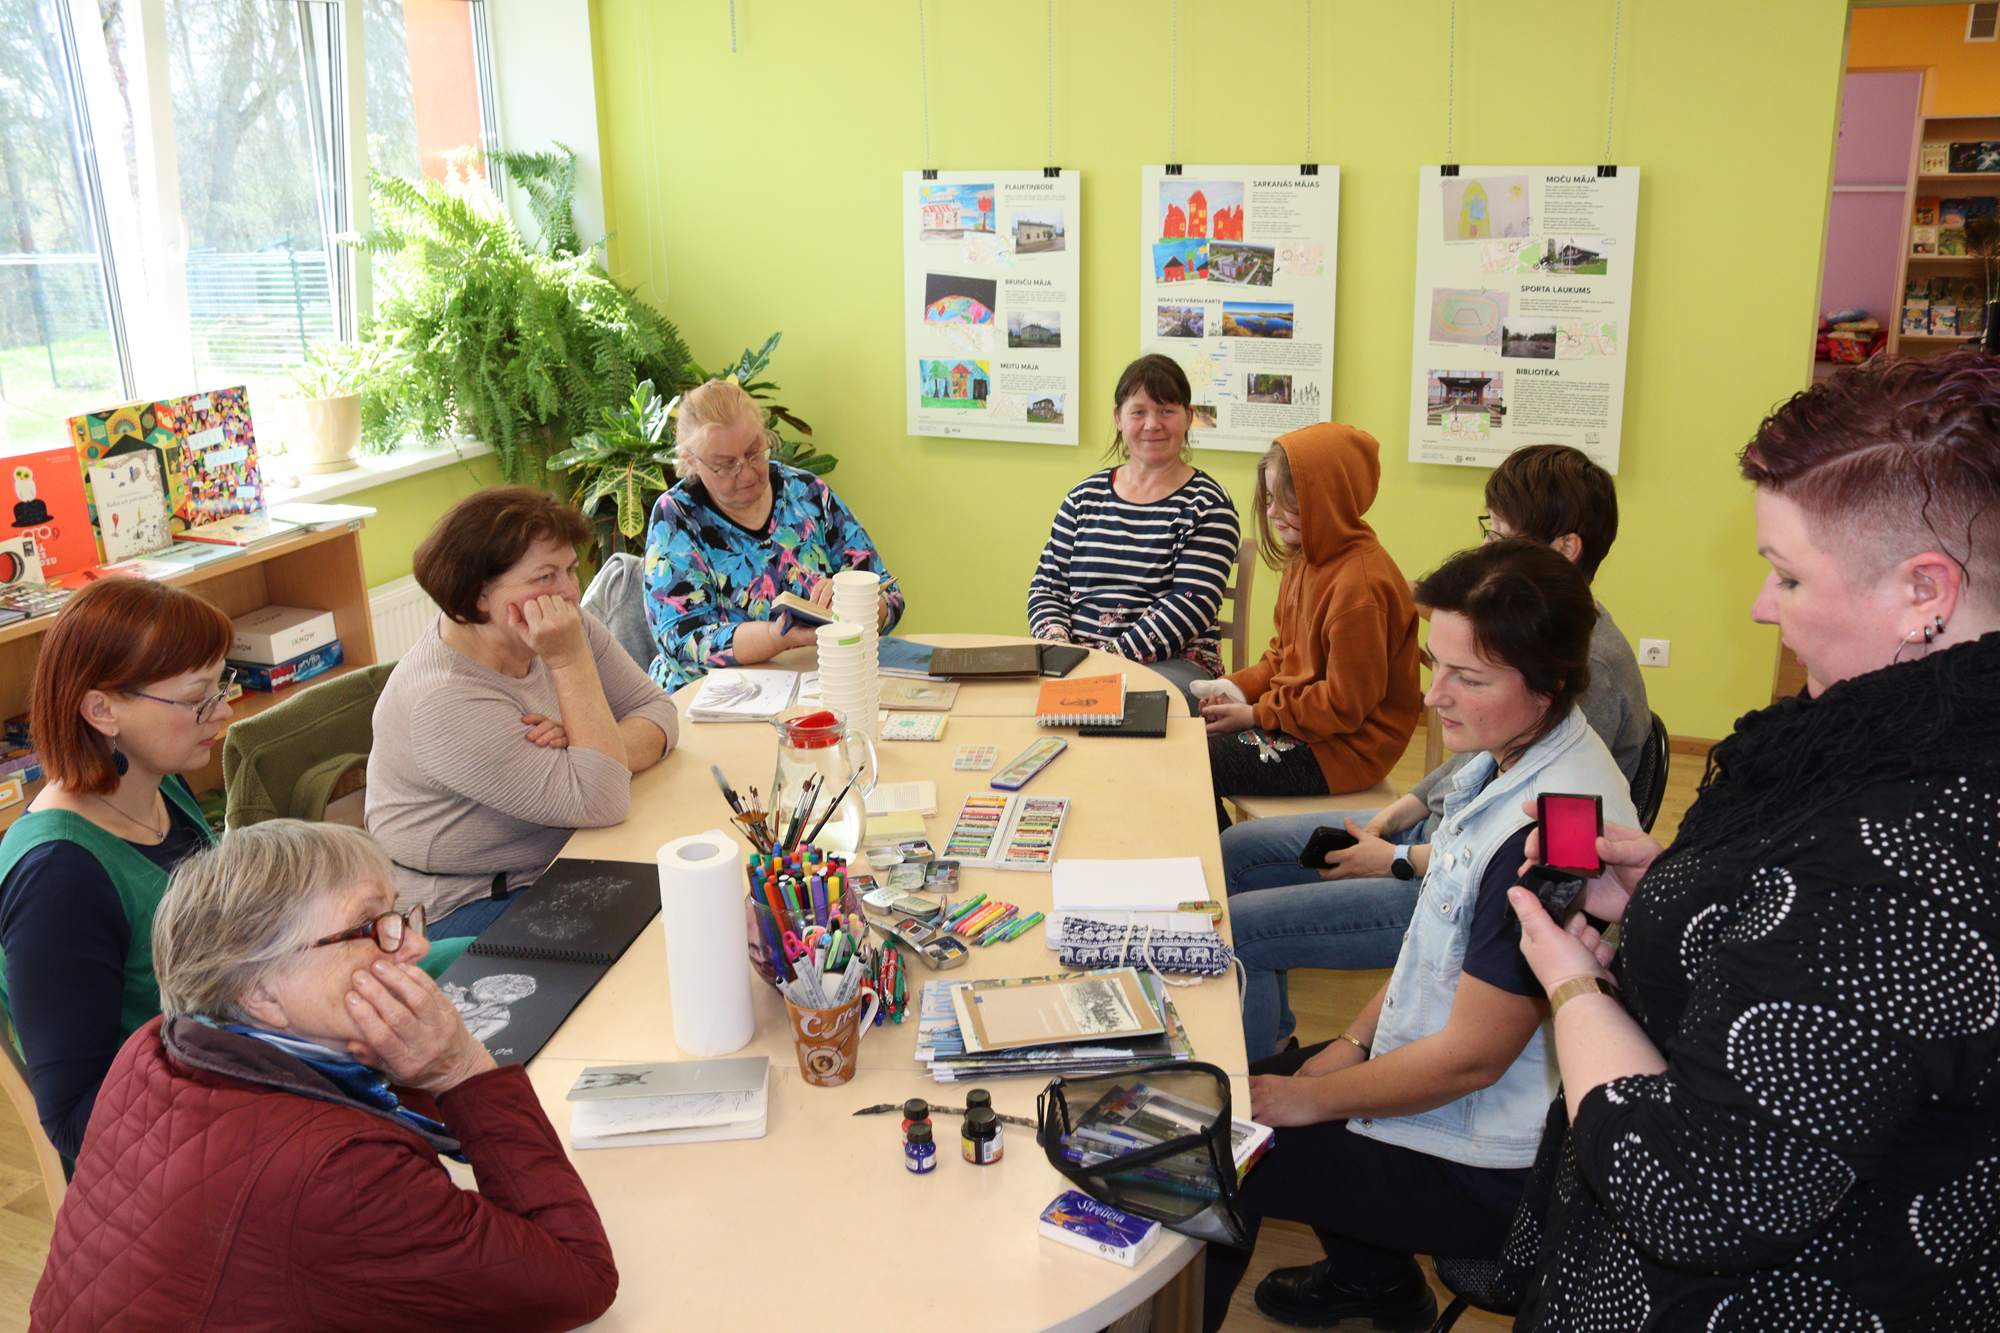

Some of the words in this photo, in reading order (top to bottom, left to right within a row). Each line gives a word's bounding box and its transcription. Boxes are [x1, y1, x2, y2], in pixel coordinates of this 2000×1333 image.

[1574, 175, 1596, 183] MĀJA
[1295, 180, 1320, 188] MĀJAS
[1521, 285, 1551, 293] SPORTA
[1553, 286, 1591, 294] LAUKUMS
[1516, 368, 1560, 376] BIBLIOTĒKA
[192, 432, 218, 448] VISI
